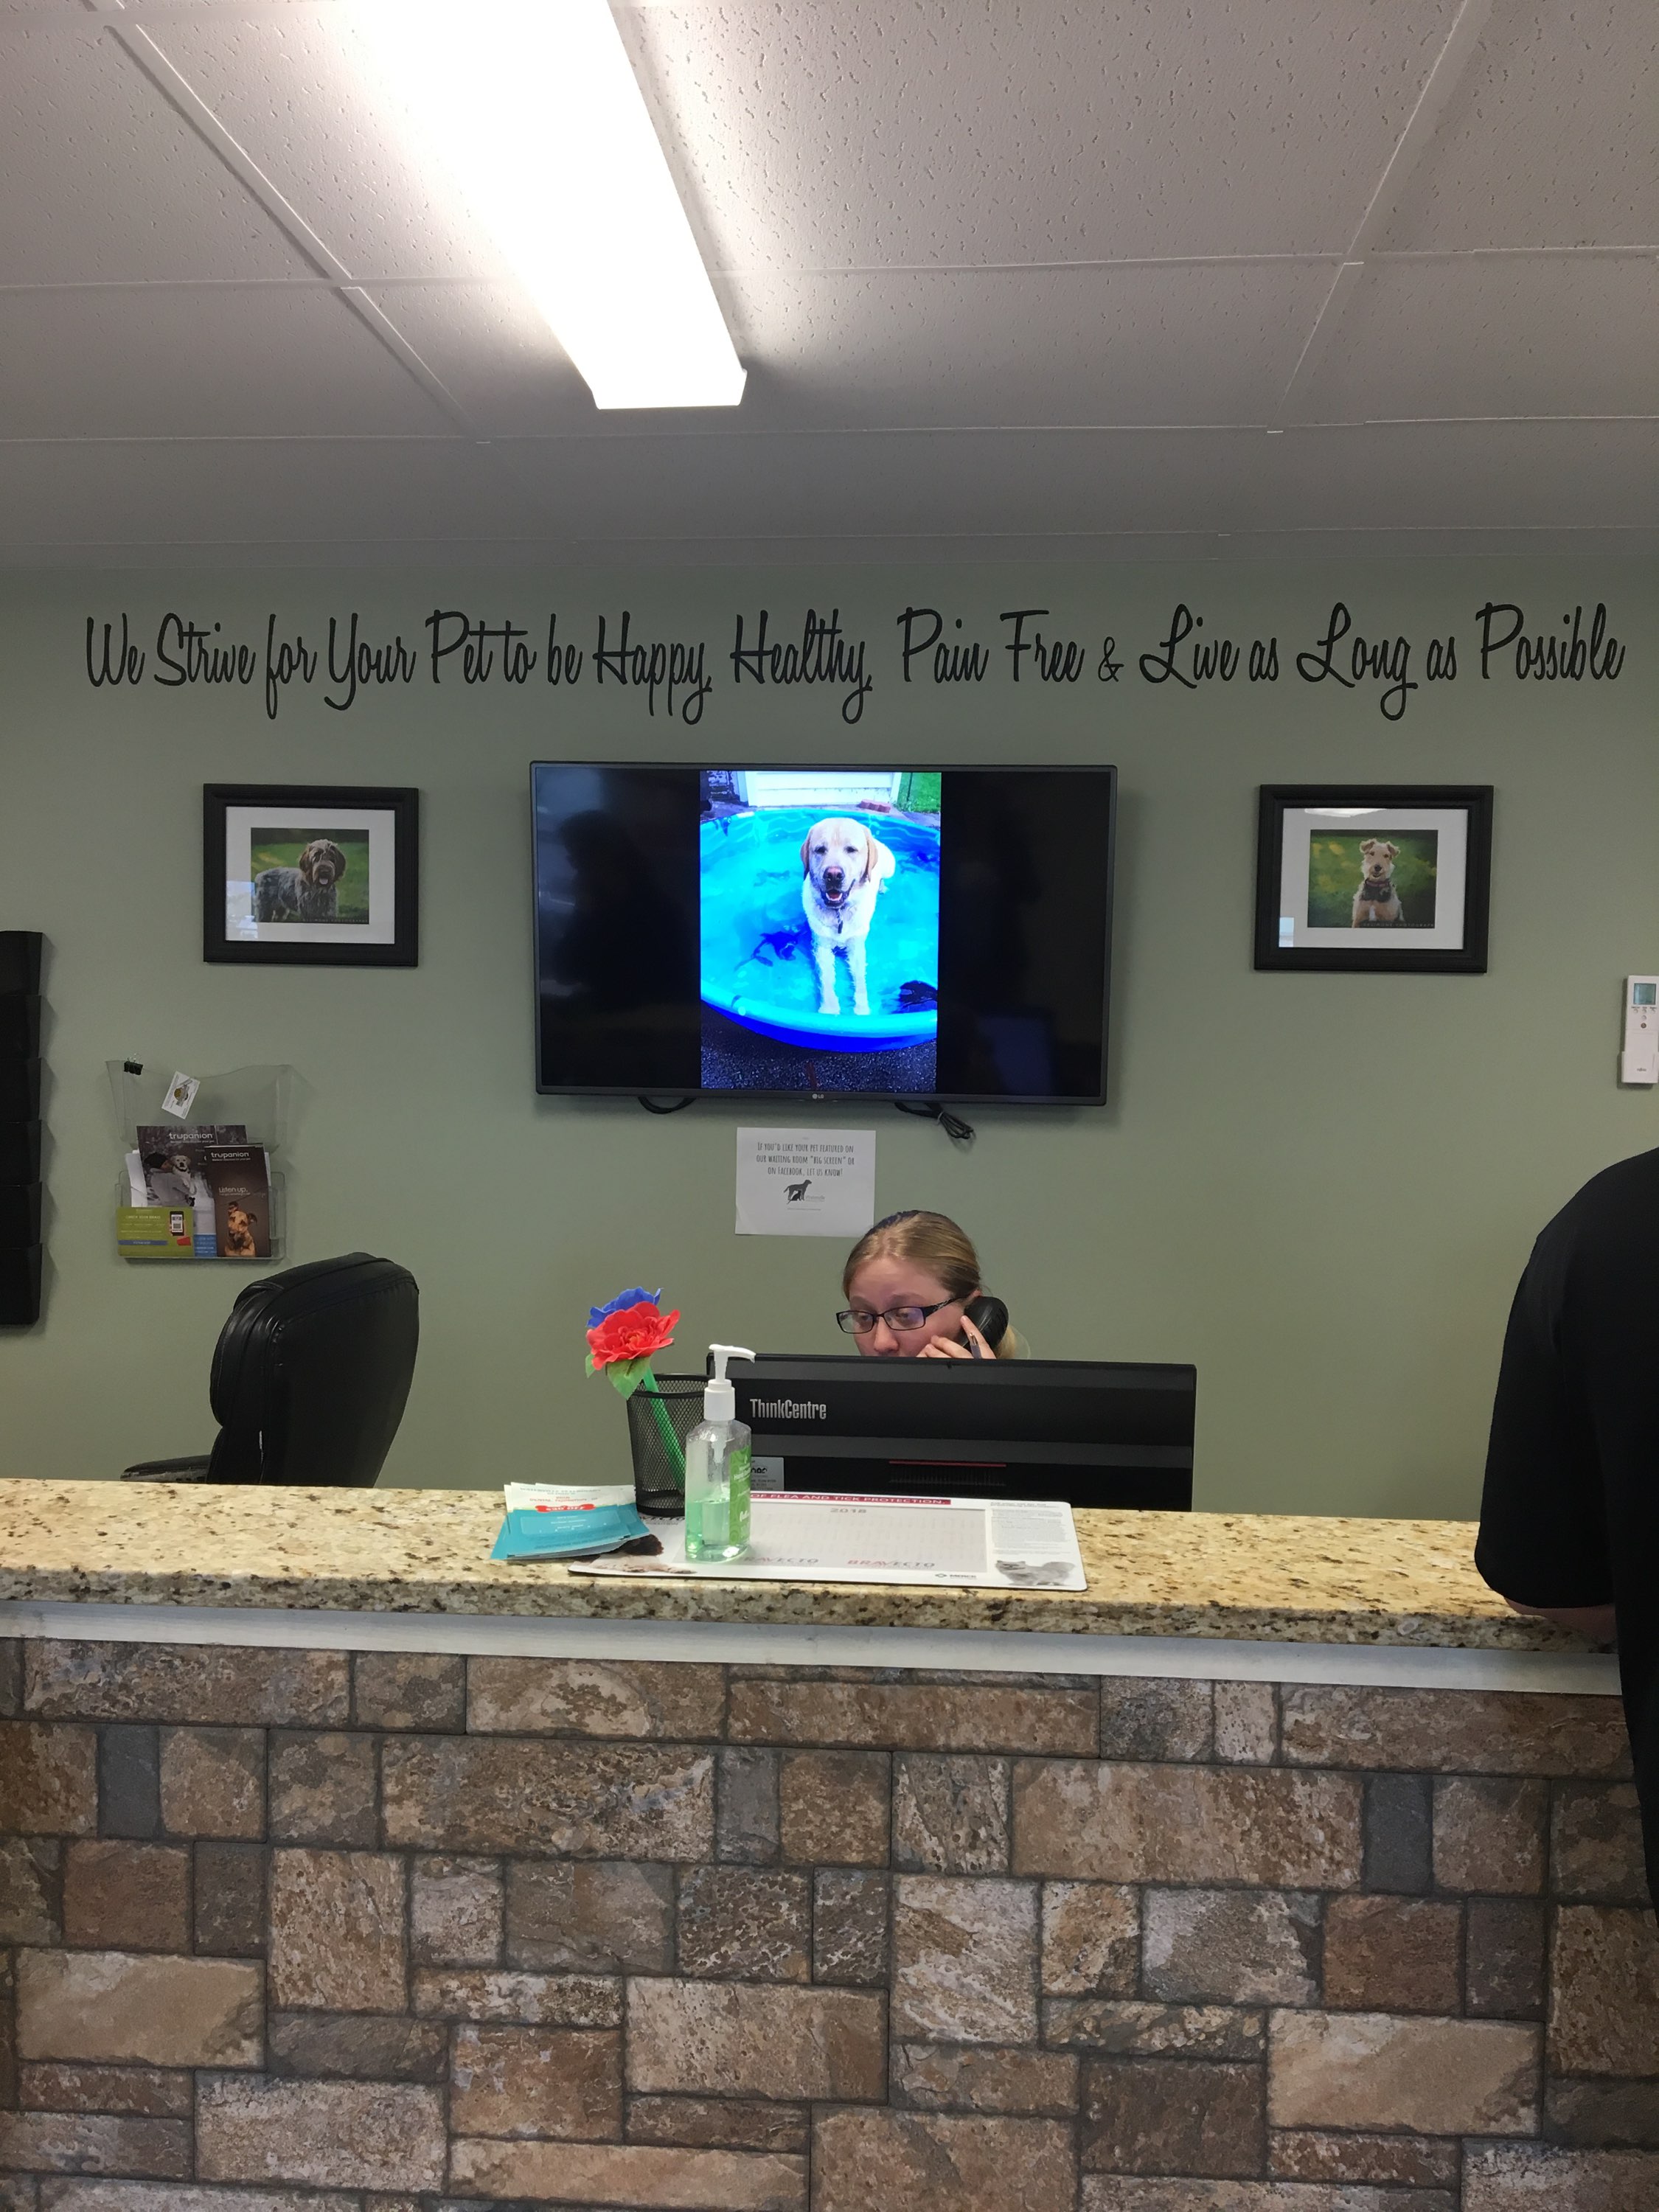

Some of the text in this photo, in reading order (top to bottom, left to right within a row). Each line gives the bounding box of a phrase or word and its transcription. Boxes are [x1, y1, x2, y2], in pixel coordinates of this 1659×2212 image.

[86, 602, 1627, 726] We Strive for Your Pet to be Happy, Healthy, Pain Free & Live as Long as Possible
[764, 1142, 781, 1152] YOU'D
[782, 1143, 793, 1152] LIKE
[795, 1144, 808, 1152] YOUR
[810, 1144, 818, 1152] PET
[819, 1144, 844, 1153] FEATURED
[845, 1145, 854, 1153] ON
[756, 1155, 855, 1165] OUR WAITING ROOM "BIG SCREEN" OR
[768, 1166, 776, 1175] ON
[807, 1168, 815, 1176] LET
[816, 1168, 823, 1176] US
[824, 1168, 843, 1177] KNOW!
[750, 1398, 827, 1420] ThinkCentre
[846, 1559, 936, 1568] BRAVECTO
